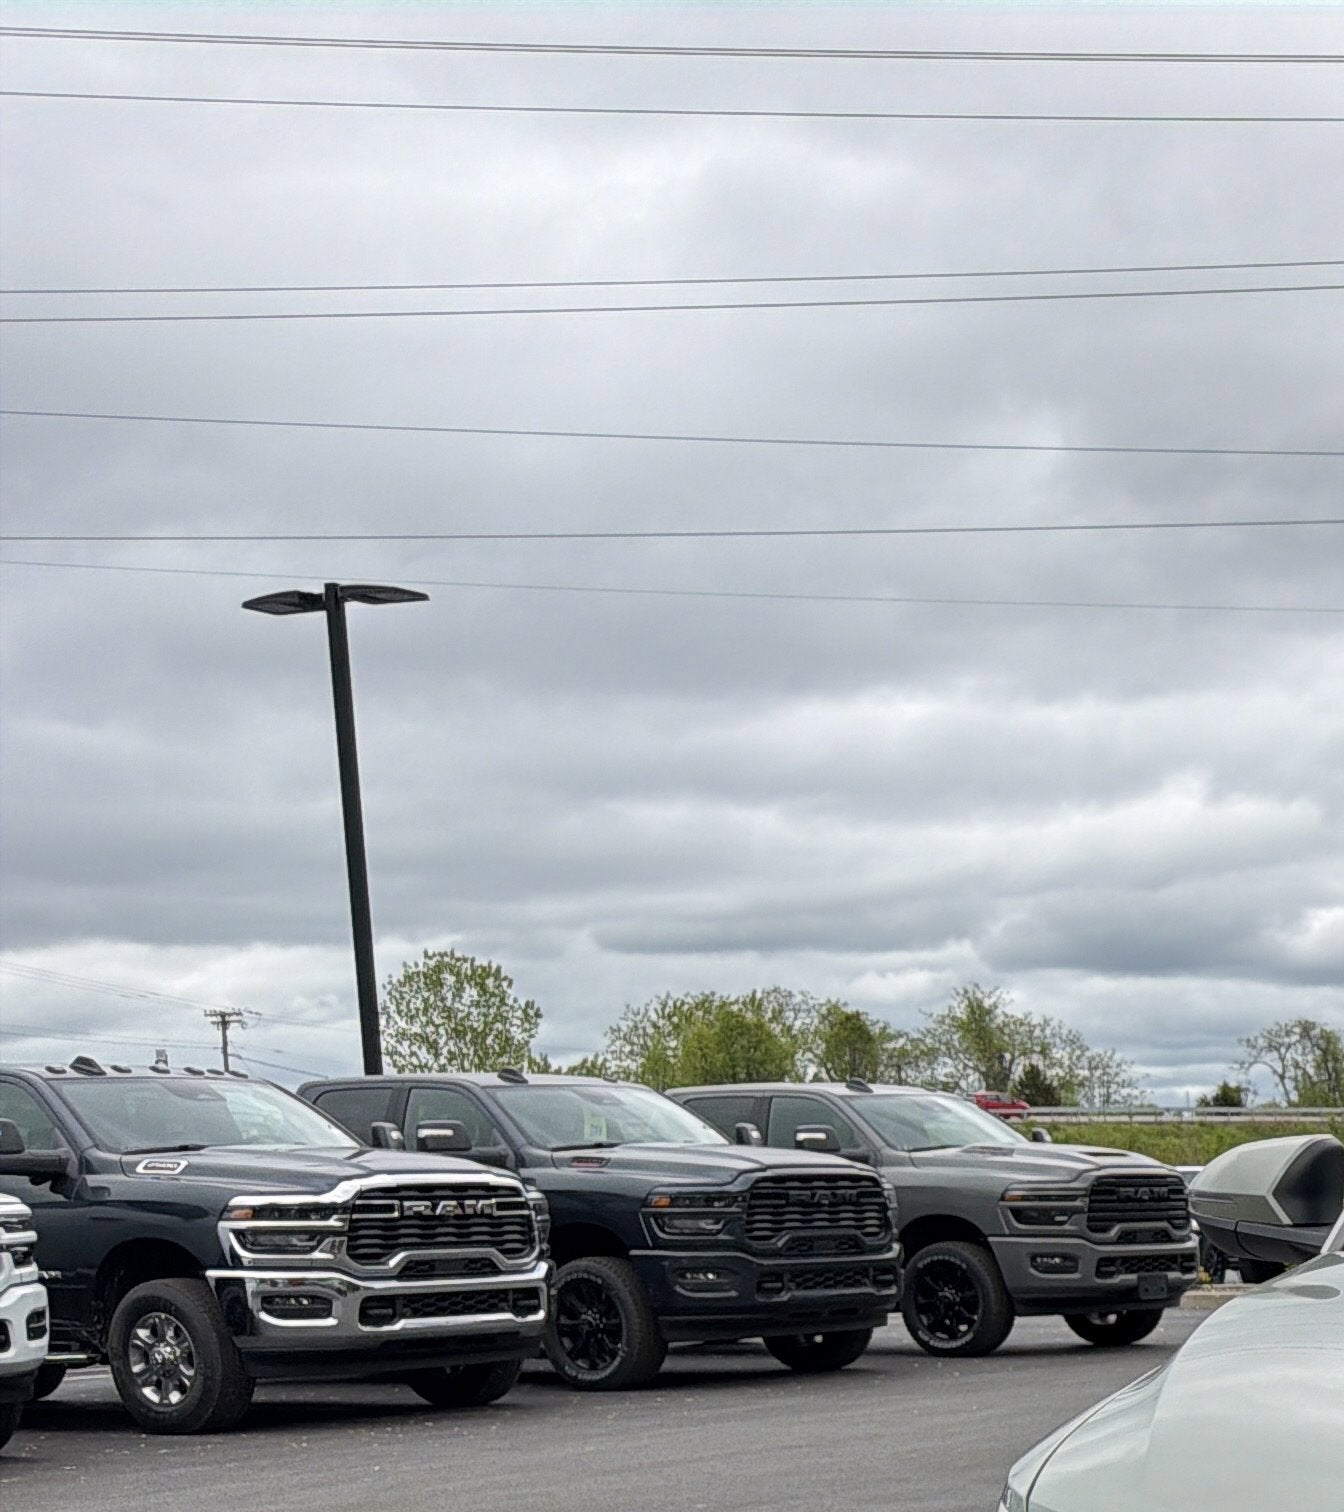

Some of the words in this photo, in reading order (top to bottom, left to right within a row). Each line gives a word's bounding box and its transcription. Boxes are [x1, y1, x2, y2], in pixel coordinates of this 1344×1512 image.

[788, 1190, 857, 1204] RAM
[1119, 1187, 1168, 1200] RAM
[402, 1200, 494, 1217] RAM
